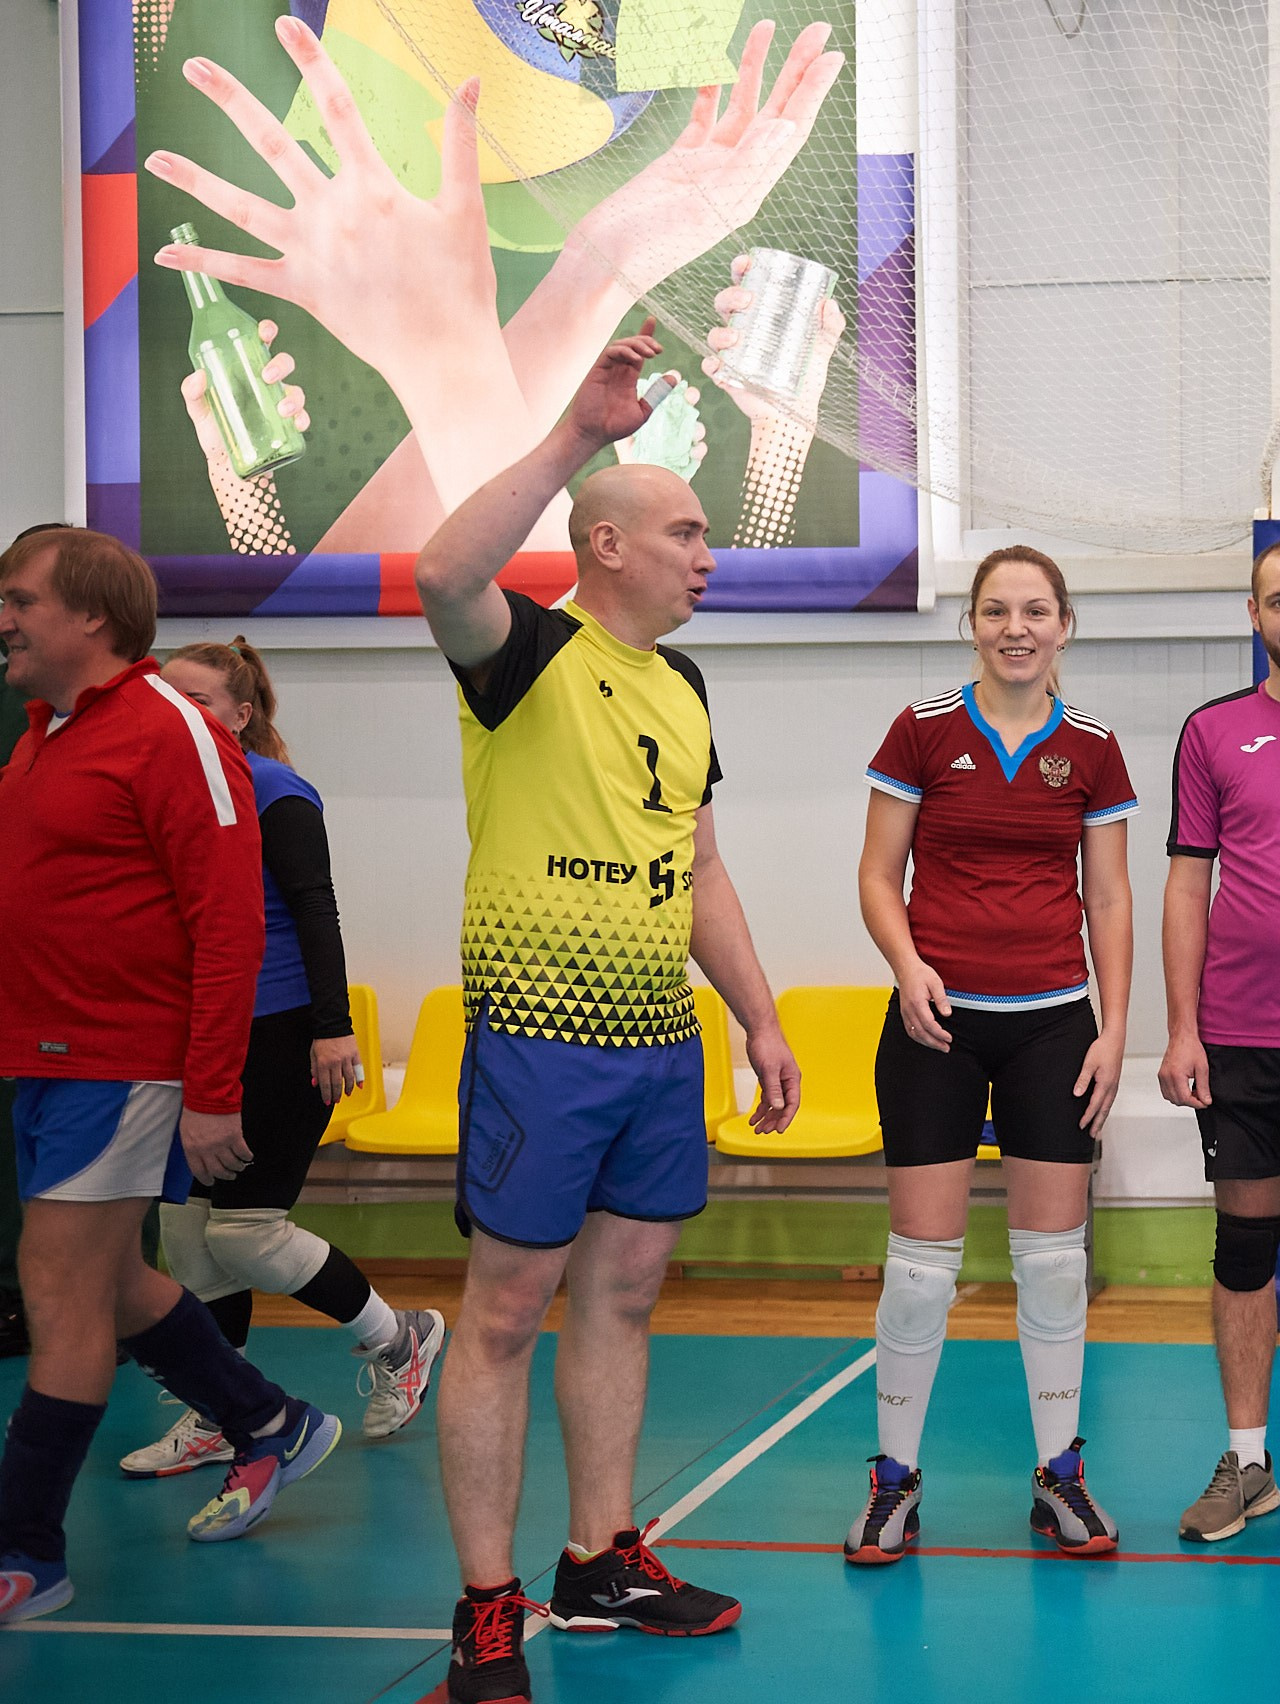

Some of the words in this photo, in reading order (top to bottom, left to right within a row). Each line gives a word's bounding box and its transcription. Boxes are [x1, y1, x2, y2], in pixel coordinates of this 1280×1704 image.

[638, 734, 673, 813] 1
[950, 762, 976, 770] adidas
[547, 854, 637, 885] HOTEY
